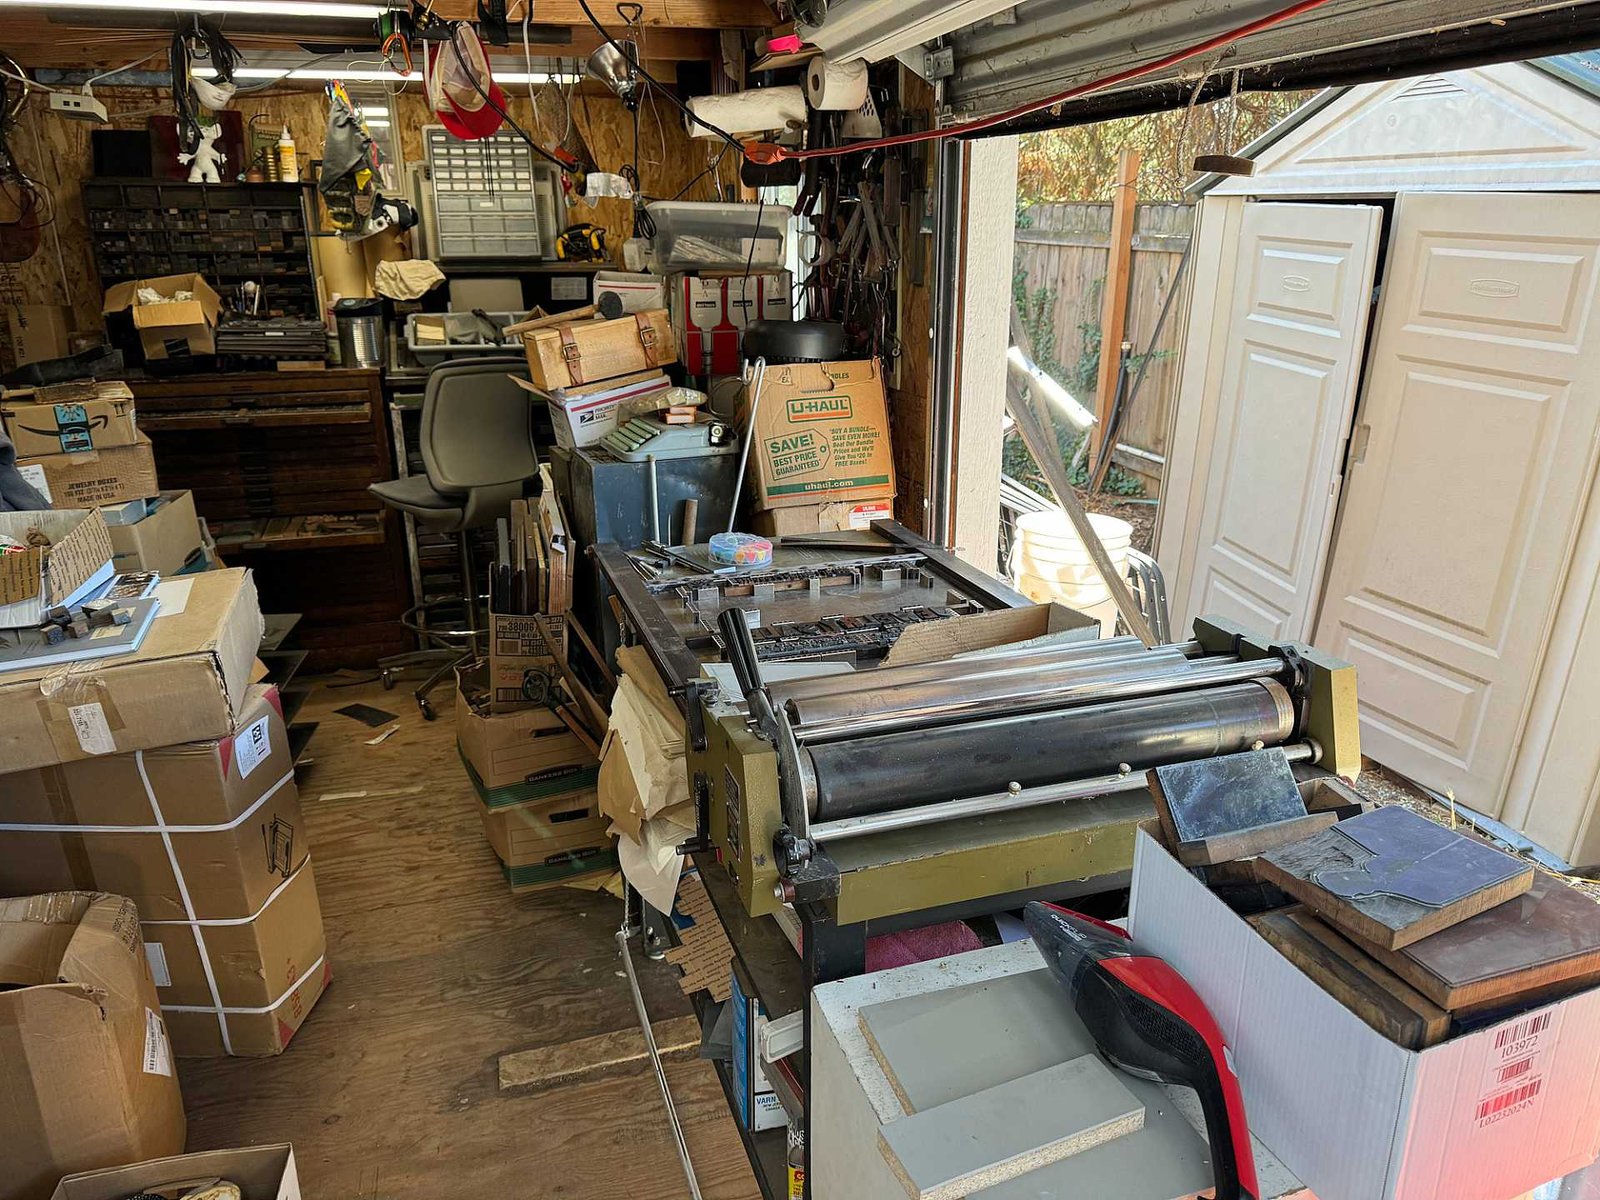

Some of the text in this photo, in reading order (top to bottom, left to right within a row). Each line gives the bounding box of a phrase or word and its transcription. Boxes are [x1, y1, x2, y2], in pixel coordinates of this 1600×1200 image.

[791, 399, 849, 414] U-HAUL
[770, 433, 815, 453] SAVE!
[773, 452, 817, 468] BEST PRICE
[97, 478, 118, 486] BOXES
[804, 479, 854, 491] uhaul.com
[77, 494, 95, 502] MADE
[1501, 1035, 1538, 1058] 103972
[756, 1095, 777, 1105] VARN
